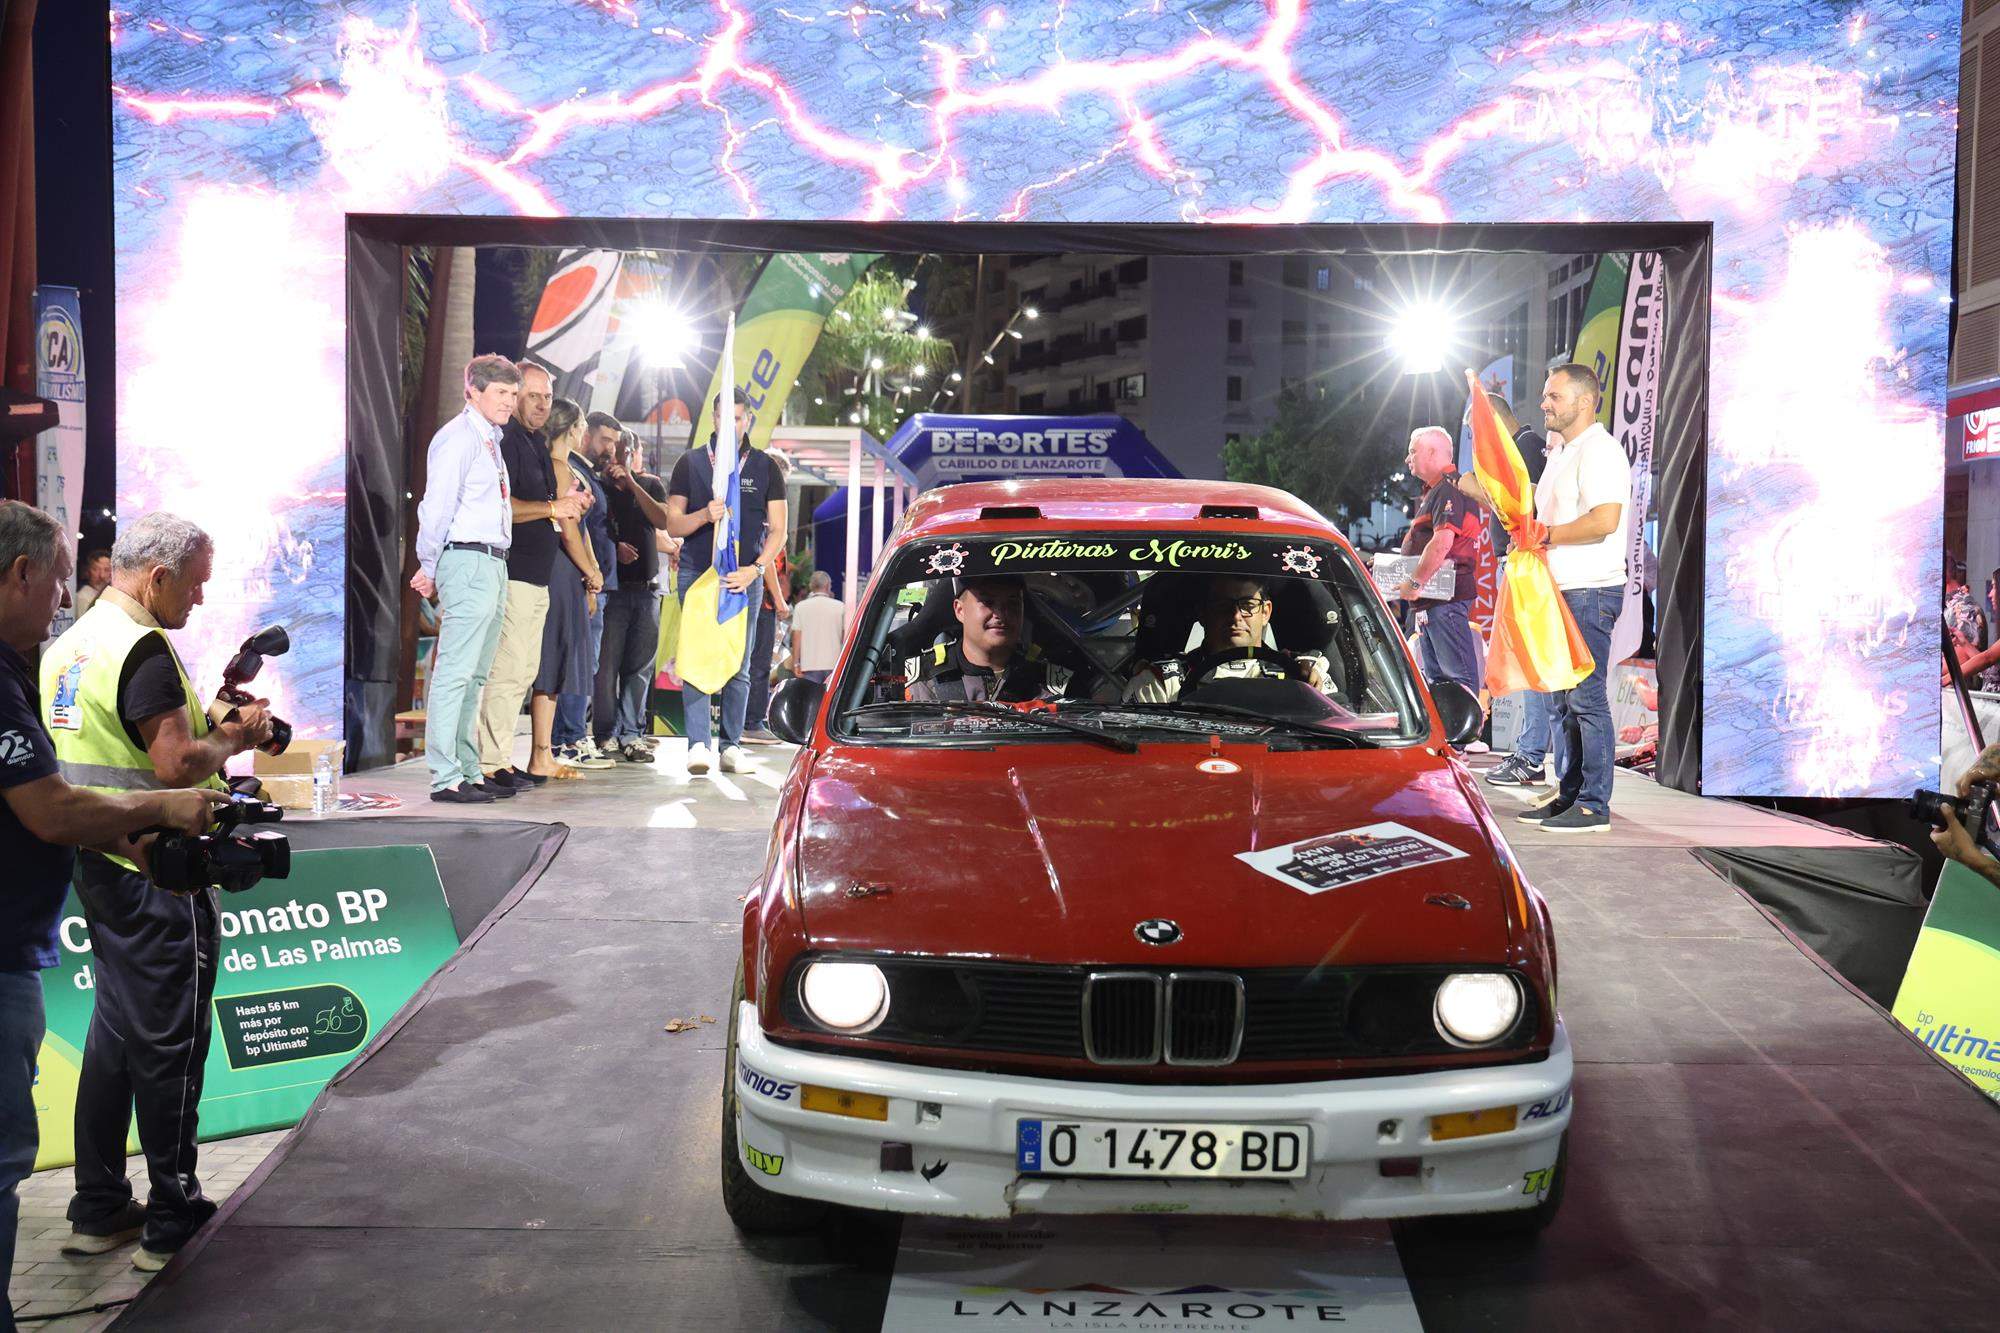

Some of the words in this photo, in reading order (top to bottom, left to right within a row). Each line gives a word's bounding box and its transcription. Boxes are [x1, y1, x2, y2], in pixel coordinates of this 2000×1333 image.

[931, 430, 1109, 454] DEPORTES
[938, 458, 998, 470] CABILDO
[1001, 459, 1019, 469] DE
[1023, 459, 1102, 470] LANZAROTE
[990, 539, 1118, 566] Pinturas
[59, 898, 330, 953] Conato
[337, 888, 389, 925] BP
[223, 949, 257, 974] de
[262, 944, 308, 969] Las
[313, 934, 402, 962] Palmas
[235, 1005, 266, 1017] Hasta
[268, 1001, 281, 1012] 56
[283, 1000, 300, 1011] km
[239, 1018, 262, 1029] más
[264, 1016, 282, 1027] por
[1917, 1010, 1934, 1026] bp
[243, 1028, 288, 1043] depósito
[290, 1025, 309, 1035] con
[246, 1044, 261, 1056] bp
[1024, 1150, 1035, 1164] E
[1104, 1128, 1217, 1171] 1478
[1240, 1130, 1300, 1172] BD
[953, 1300, 1347, 1323] LANZAROTE
[1085, 1322, 1129, 1330] ISLA
[1138, 1323, 1252, 1331] DIFERENTE
